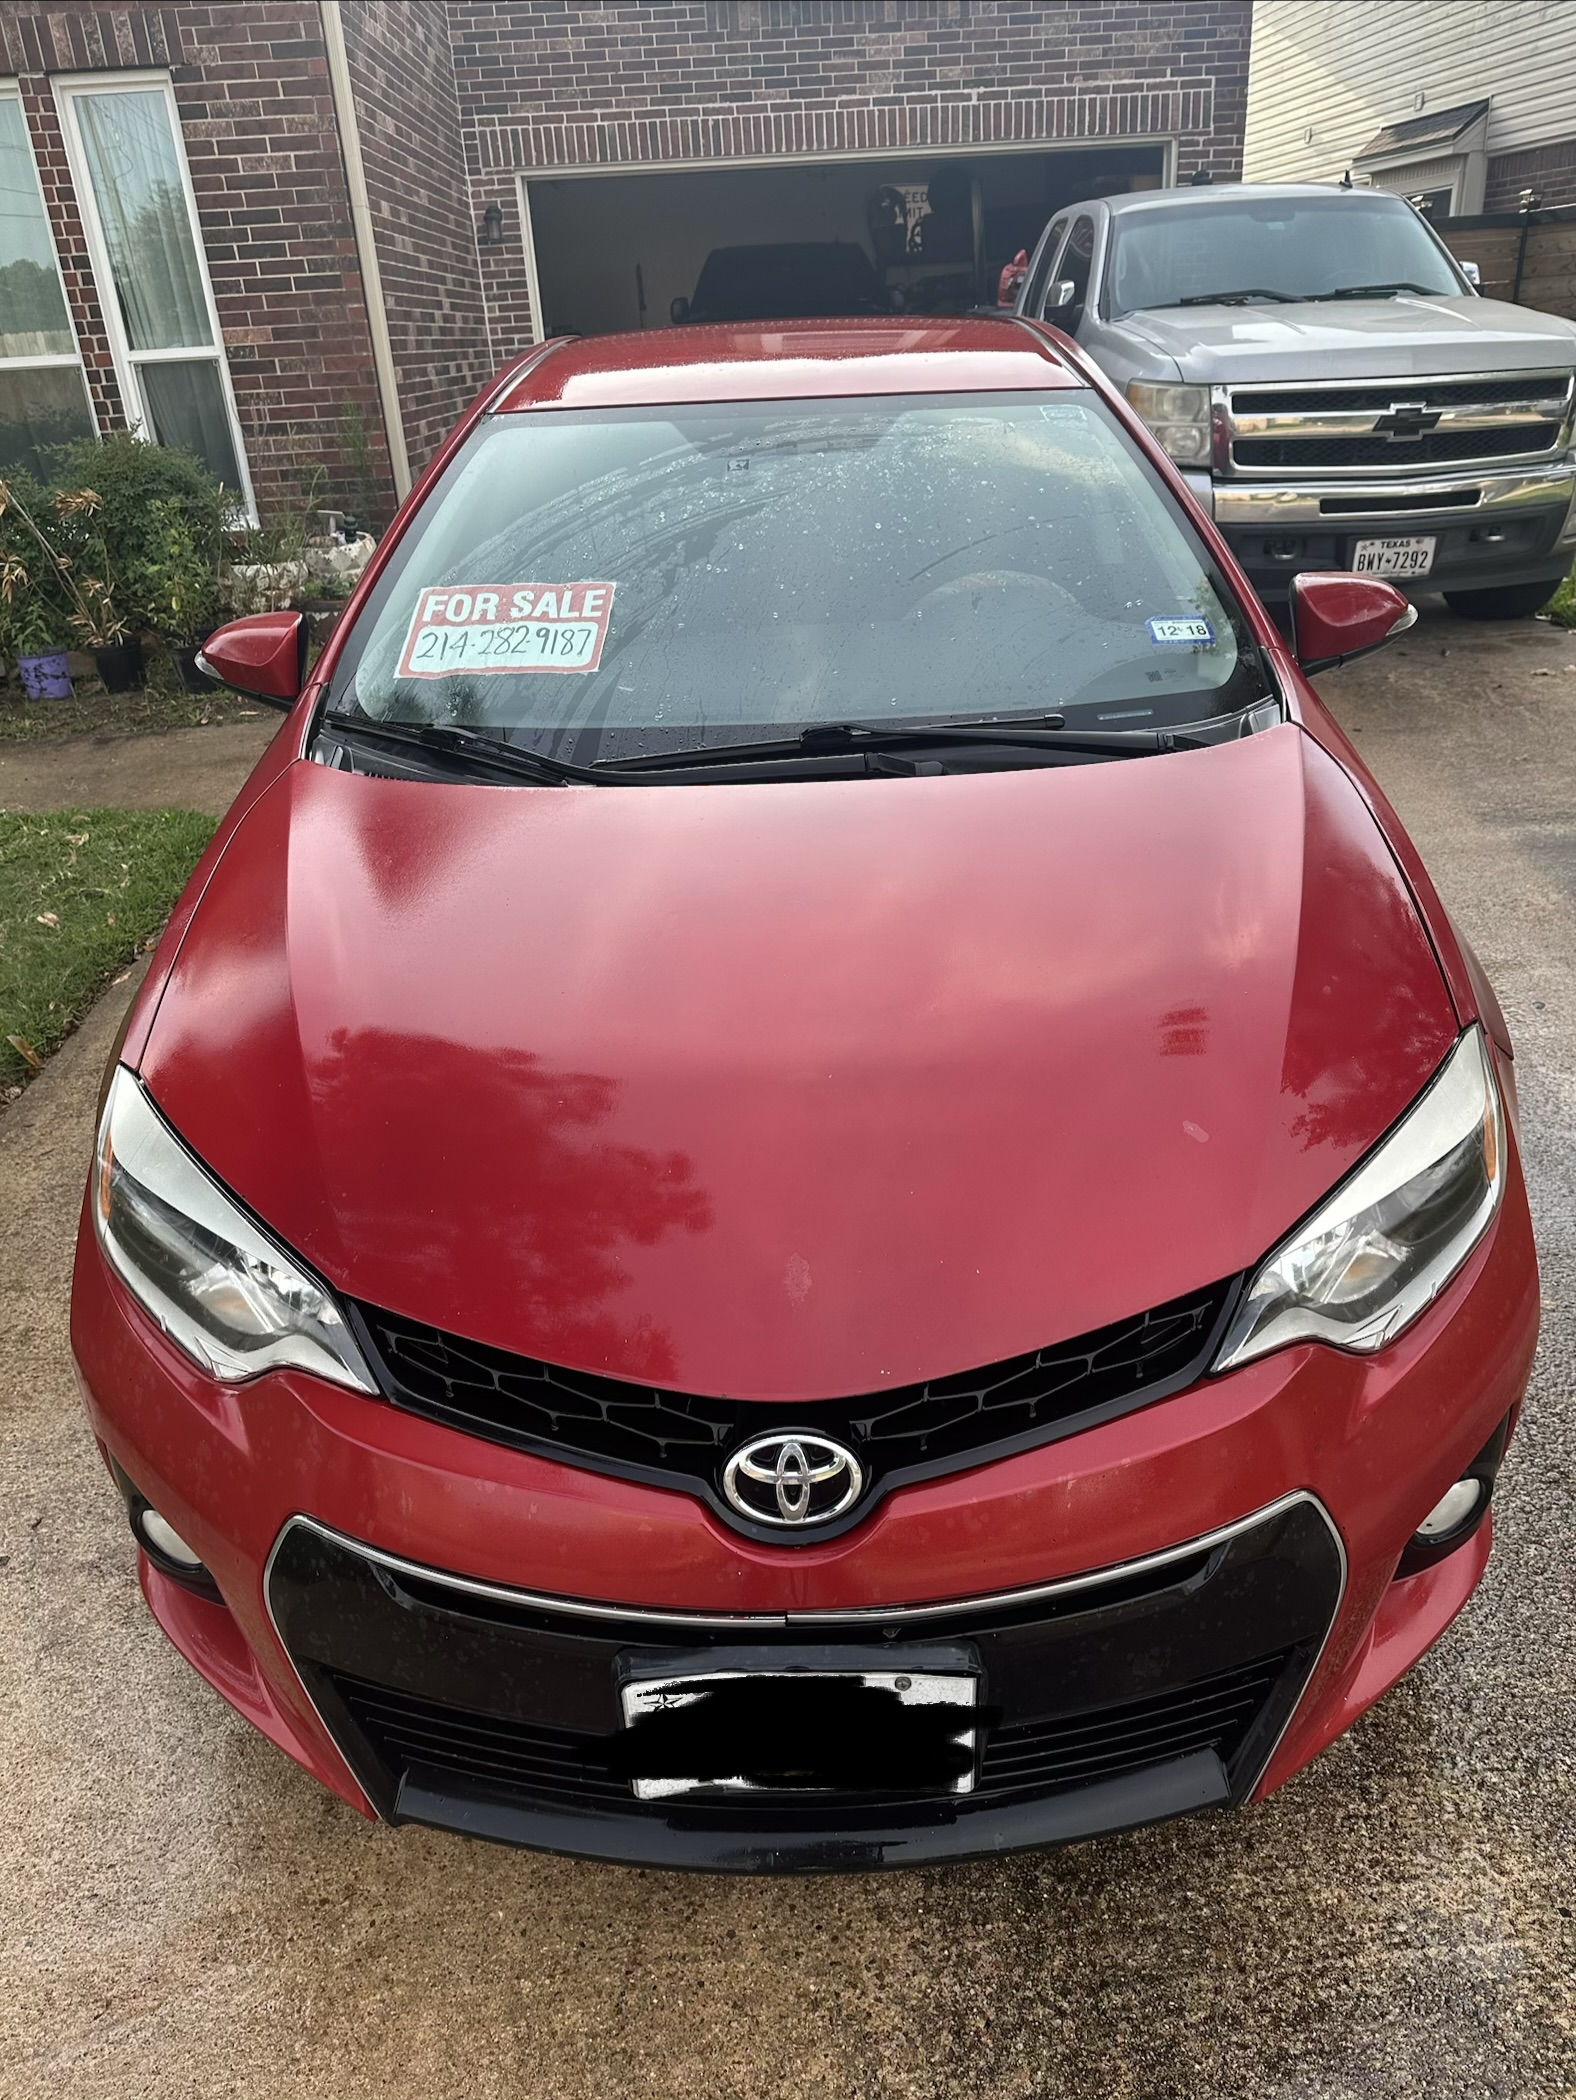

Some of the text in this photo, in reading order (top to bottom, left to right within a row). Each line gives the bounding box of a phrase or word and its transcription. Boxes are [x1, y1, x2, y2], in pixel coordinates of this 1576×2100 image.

[903, 192, 929, 203] EED
[1381, 540, 1411, 549] TEXAS
[422, 590, 607, 623] FOR SALE
[416, 625, 593, 661] 214-282-9187
